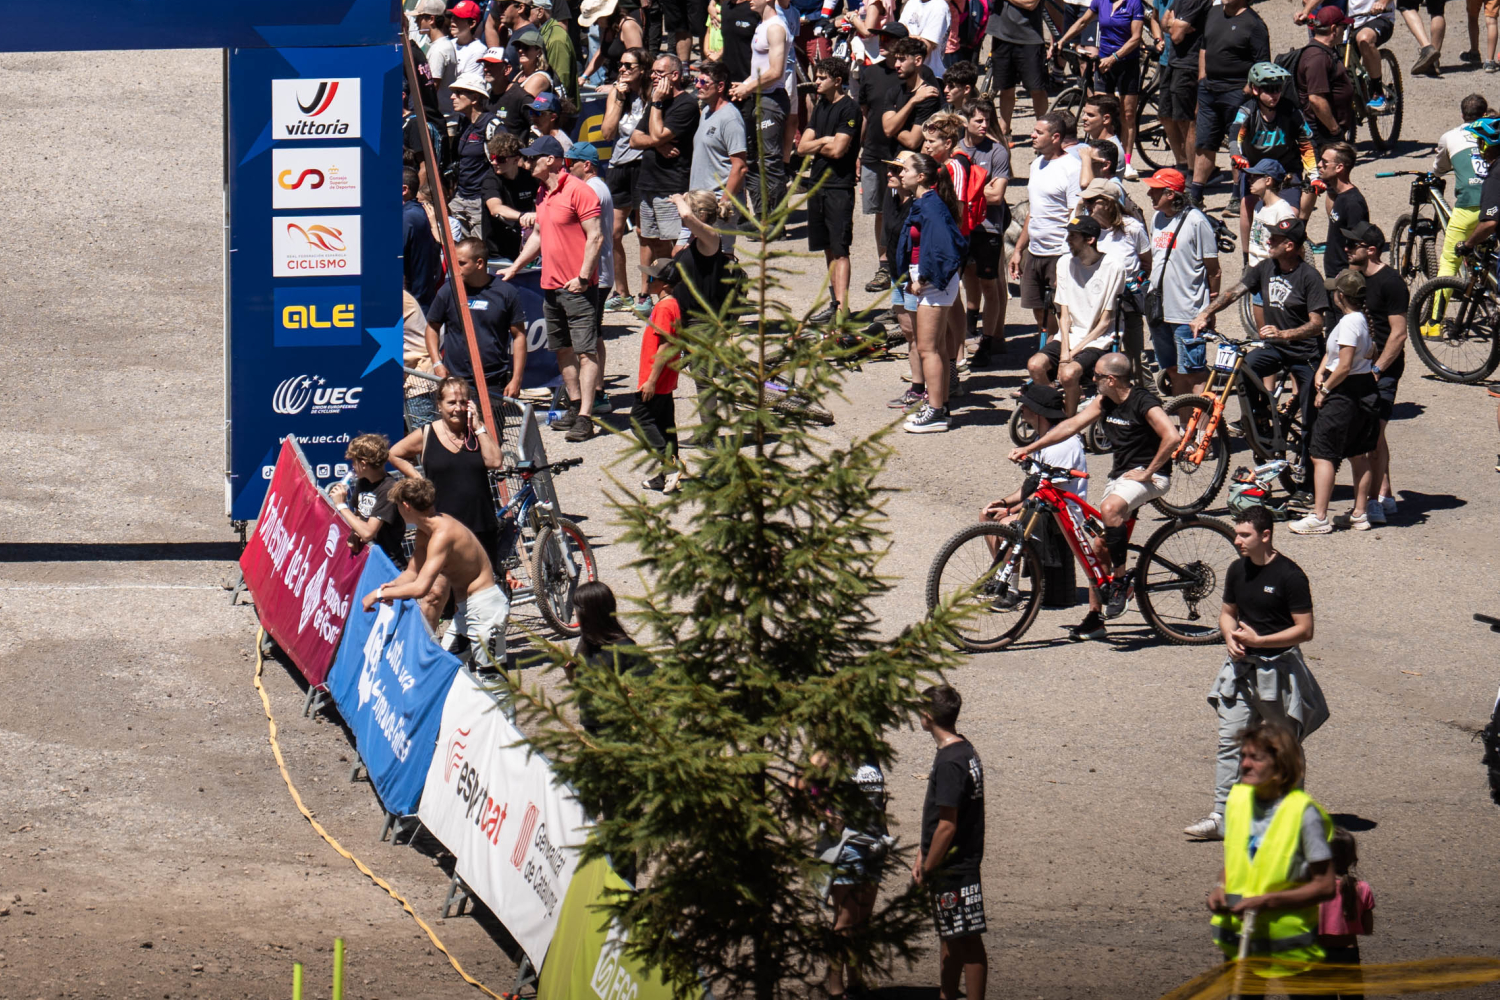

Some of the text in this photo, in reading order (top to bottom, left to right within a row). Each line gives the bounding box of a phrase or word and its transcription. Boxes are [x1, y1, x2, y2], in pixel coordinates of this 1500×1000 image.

[286, 120, 349, 136] vittoria
[287, 259, 346, 270] CICLISMO
[313, 386, 363, 405] UEC
